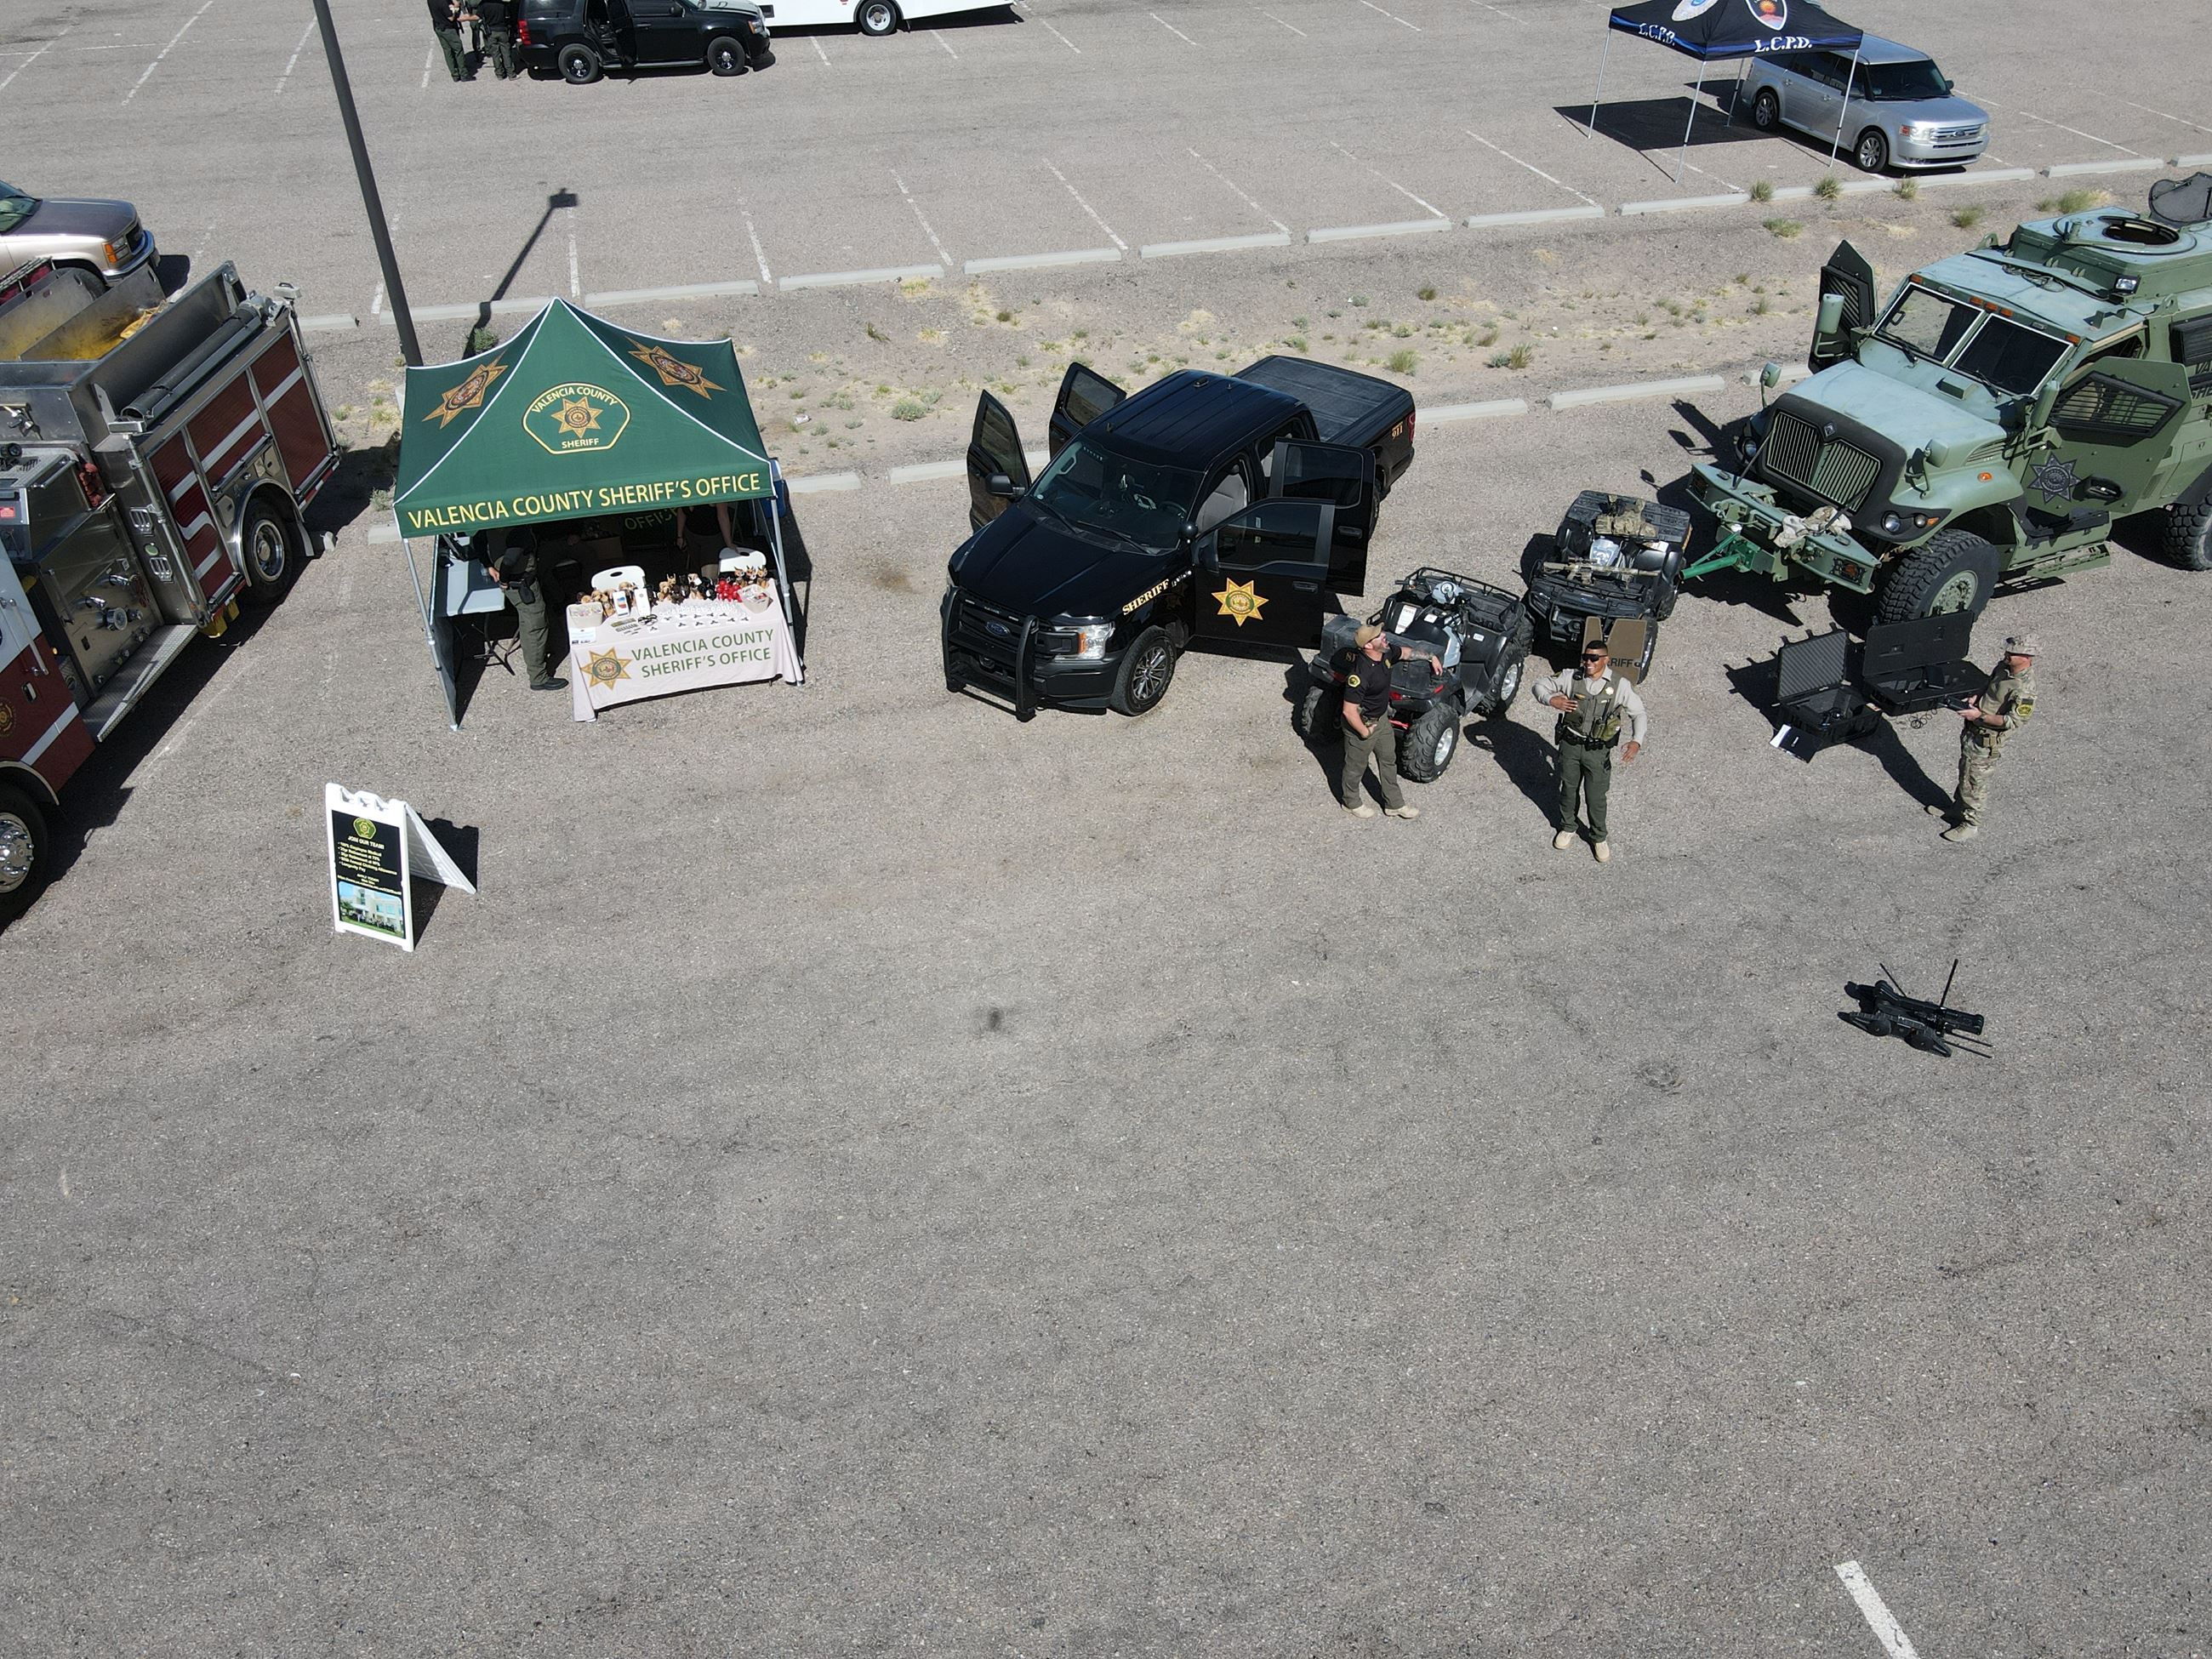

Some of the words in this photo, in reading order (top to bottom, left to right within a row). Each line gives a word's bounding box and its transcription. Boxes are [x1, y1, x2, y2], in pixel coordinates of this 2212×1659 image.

[1639, 23, 1675, 46] L.C.P.D.
[1754, 36, 1813, 54] L.C.P.D.
[532, 386, 575, 413] VALENCIA
[576, 386, 619, 407] COUNTY
[562, 438, 600, 449] SHERIFF
[408, 499, 510, 529] VALENCIA
[512, 489, 593, 516] COUNTY
[598, 480, 692, 508] SHERIFF'S
[695, 473, 761, 497] OFFICE
[1122, 579, 1170, 616] SHERIFF
[631, 639, 708, 661] VALENCIA
[712, 629, 773, 648] COUNTY
[641, 654, 715, 678] SHERIFF'S
[720, 647, 771, 664] OFFICE
[1609, 658, 1633, 668] RIFF
